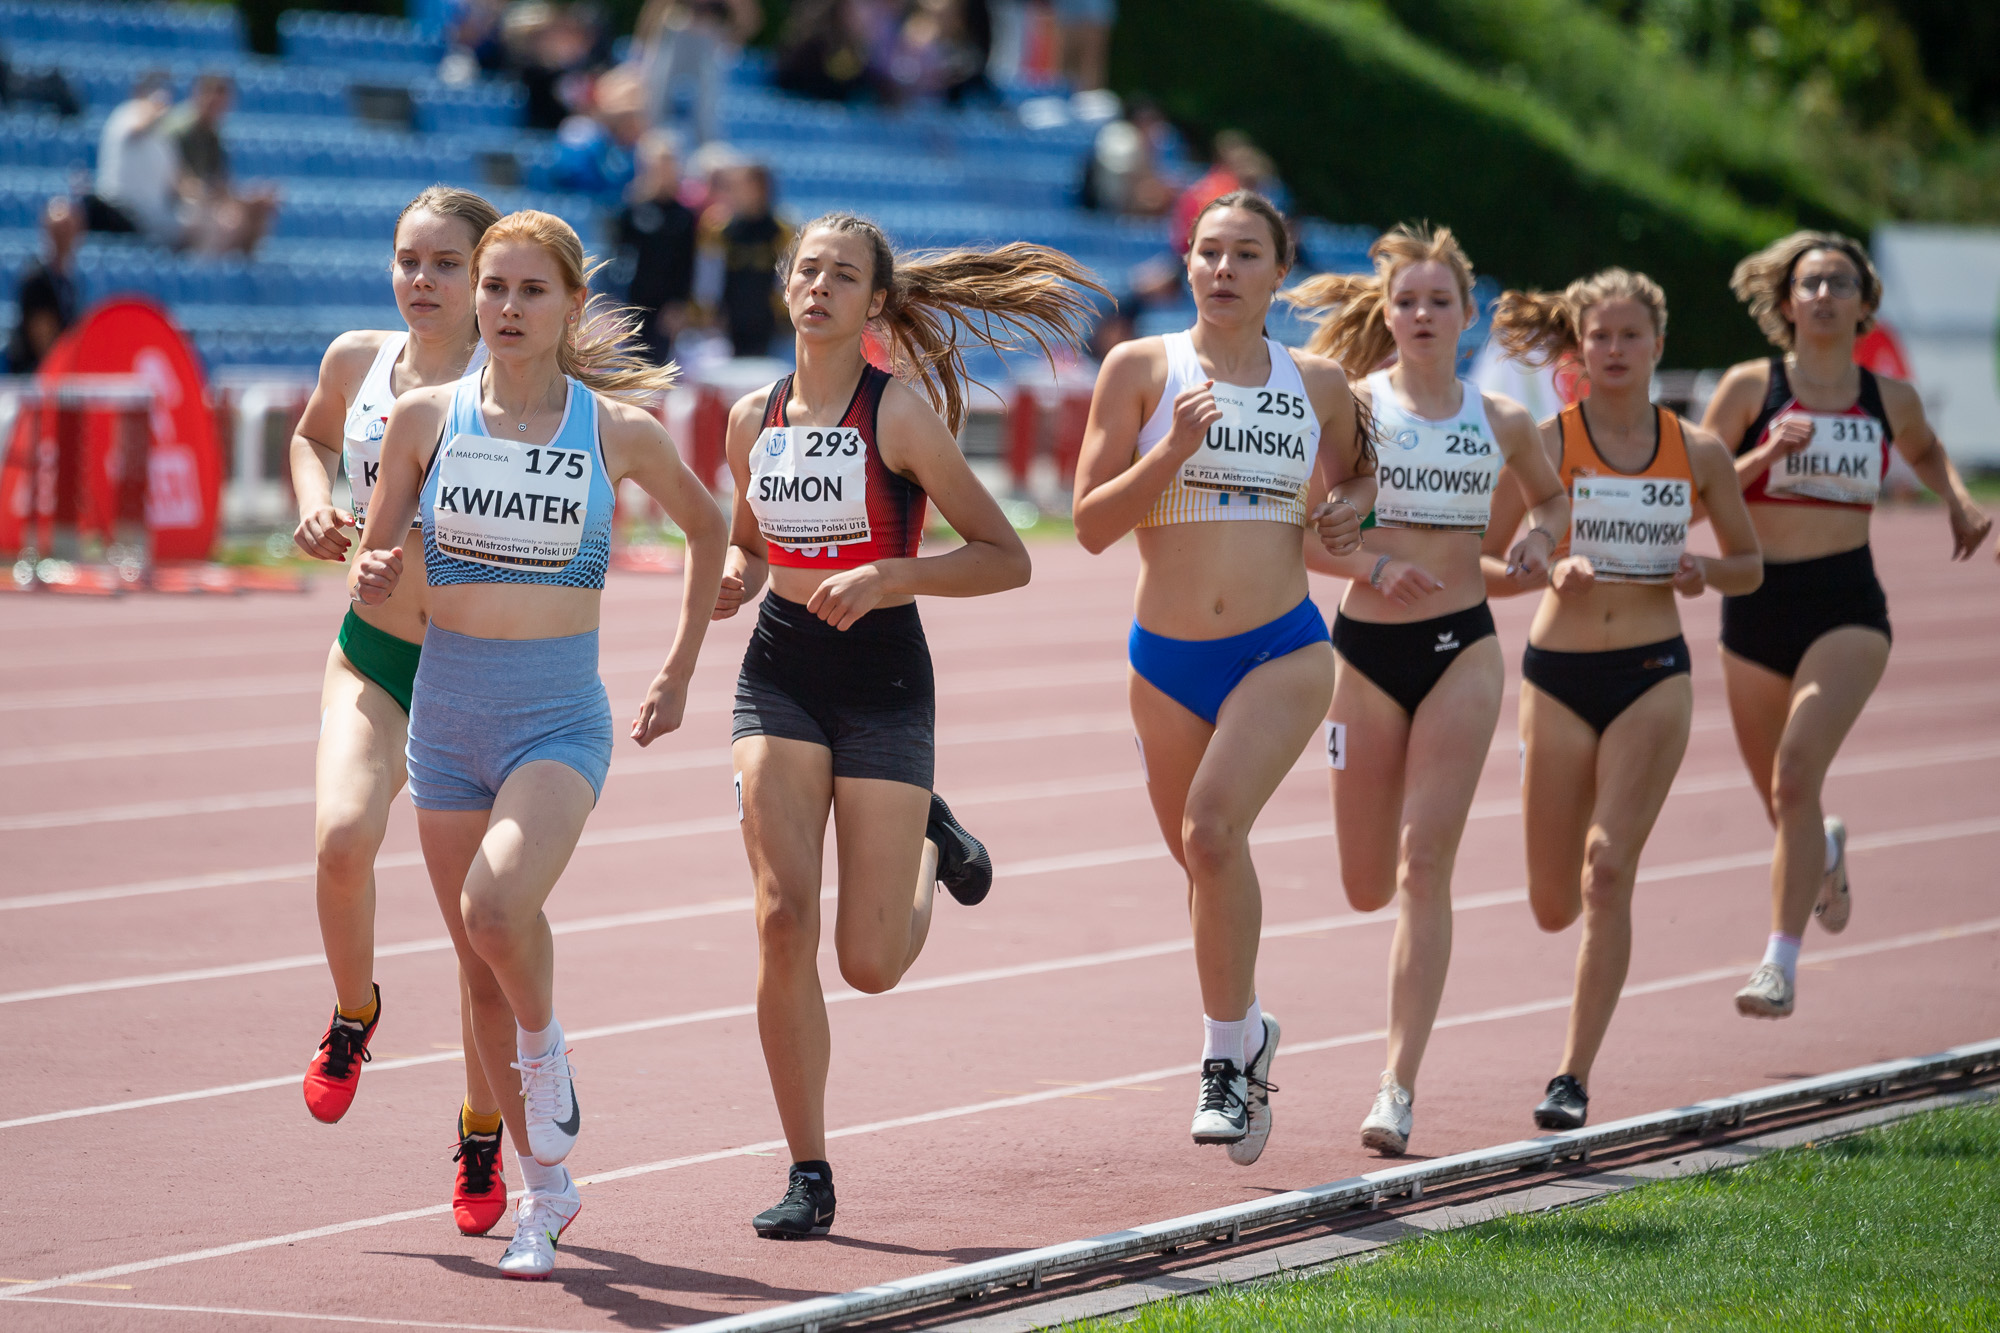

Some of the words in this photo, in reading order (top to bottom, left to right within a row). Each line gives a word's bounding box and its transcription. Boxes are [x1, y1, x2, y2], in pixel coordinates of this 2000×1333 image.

[1214, 396, 1244, 407] OPOLSKA
[1256, 391, 1305, 420] 255
[804, 431, 859, 457] 293
[1206, 424, 1306, 462] ULIŃSKA
[1832, 421, 1876, 443] 311
[455, 450, 509, 463] MAŁOPOLSKA
[525, 448, 585, 480] 175
[1786, 453, 1869, 479] BIELAK
[759, 476, 842, 502] SIMON
[1199, 471, 1220, 480] PZLA
[1222, 472, 1272, 485] Mistrzostwa
[1380, 466, 1491, 495] POLKOWSKA
[439, 486, 582, 525] KWIATEK
[1641, 483, 1685, 507] 365
[776, 524, 820, 533] Mistrzostwa
[821, 522, 848, 533] Polski
[849, 521, 867, 530] U18
[1575, 518, 1686, 545] KWIATKOWSKA
[437, 531, 450, 542] 54.
[451, 534, 473, 546] PZLA
[475, 538, 530, 554] Mistrzostwa
[532, 545, 560, 556] Polski
[562, 547, 578, 556] U18
[1327, 726, 1339, 765] 4
